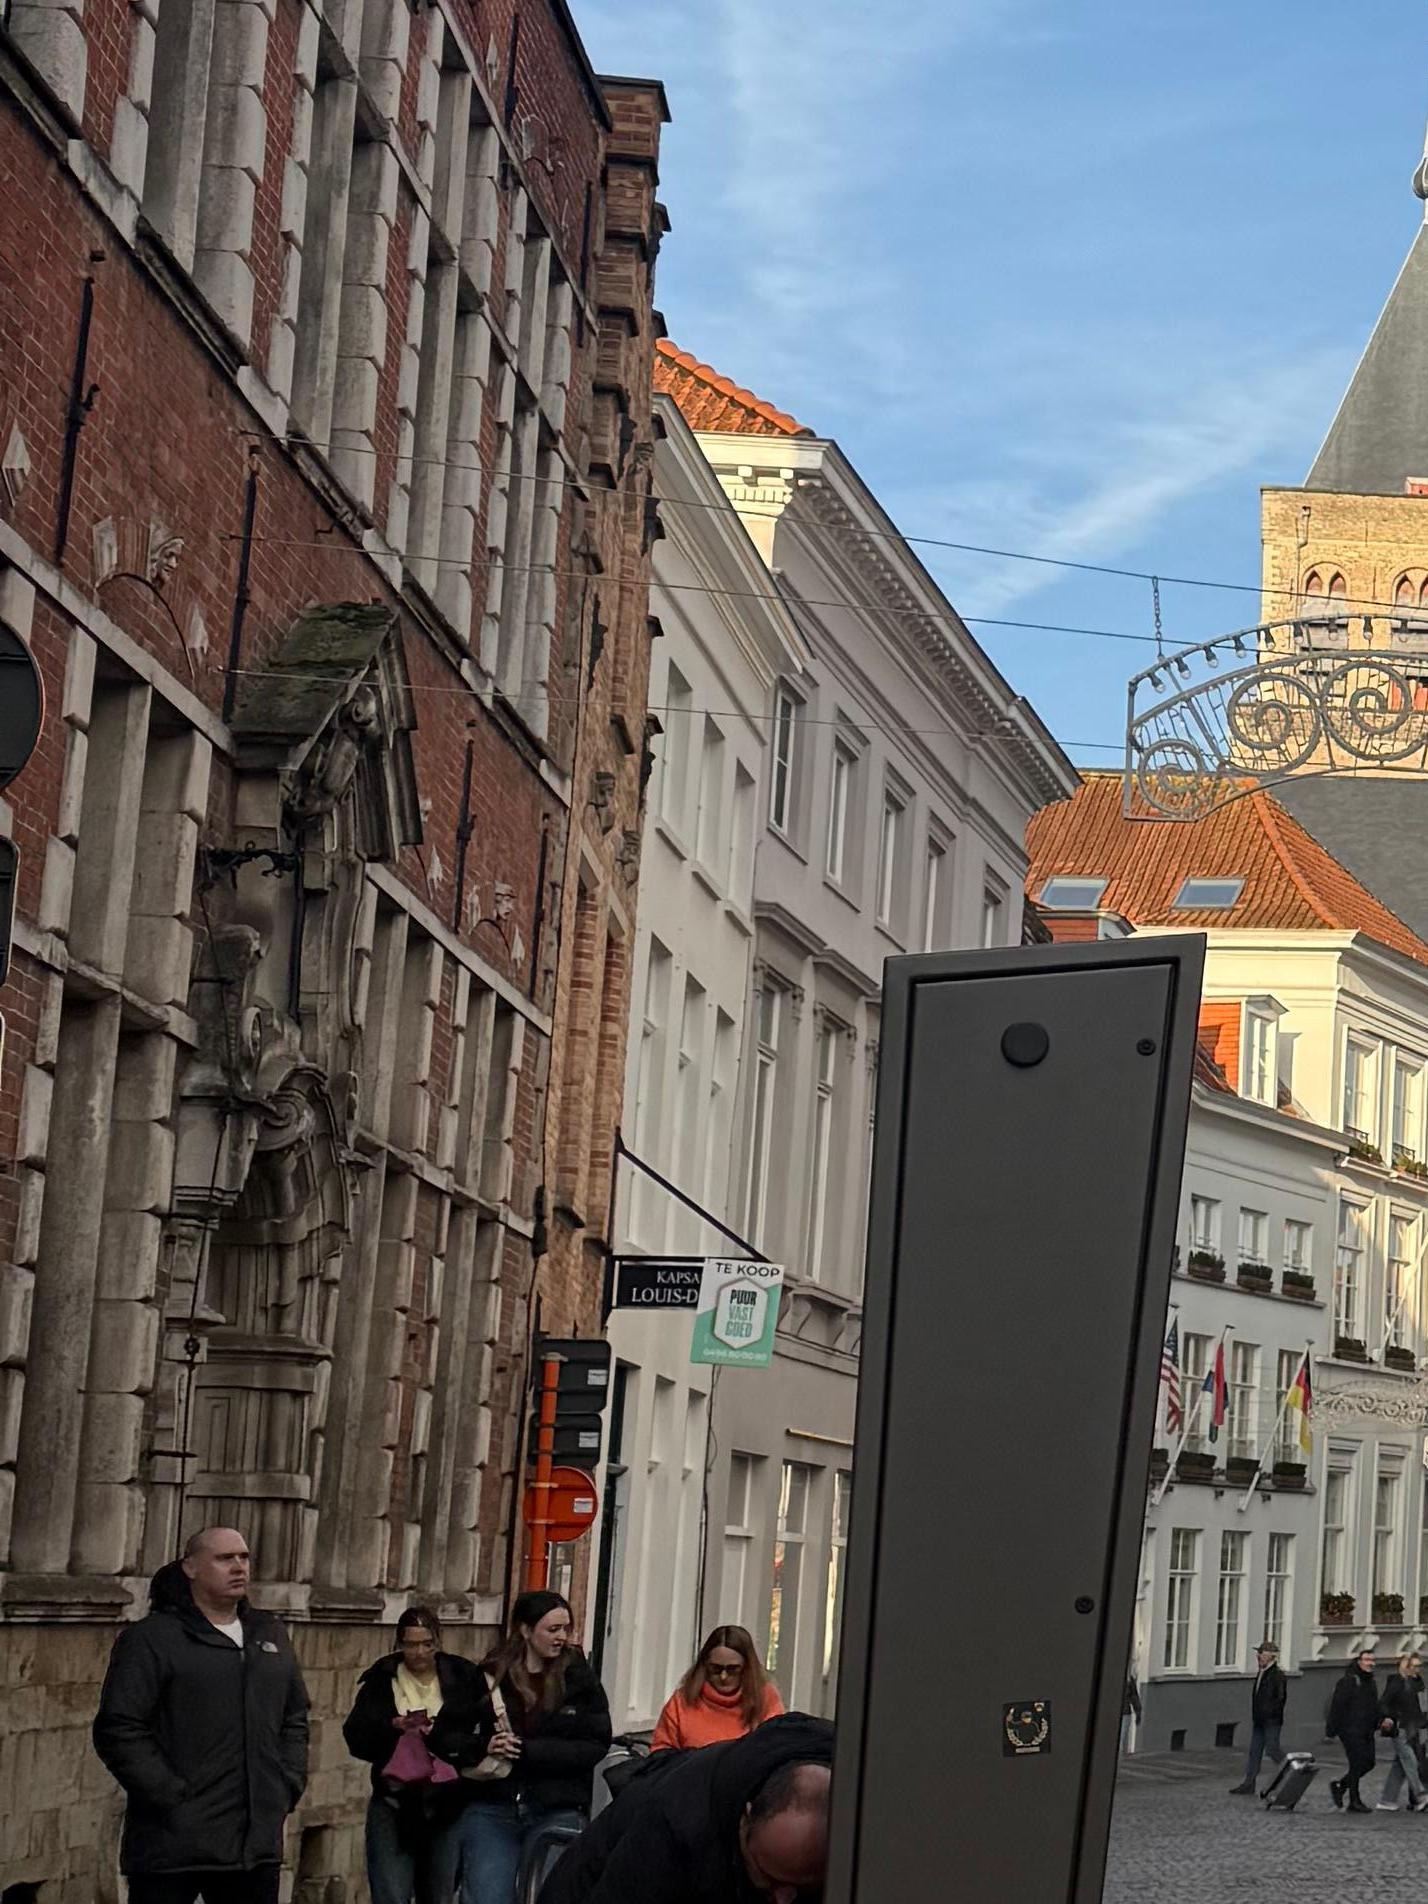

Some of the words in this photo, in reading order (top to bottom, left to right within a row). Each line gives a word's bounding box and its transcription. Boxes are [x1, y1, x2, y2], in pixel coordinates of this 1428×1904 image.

[716, 1262, 732, 1274] TE
[737, 1265, 780, 1278] KOOP
[730, 1289, 757, 1306] PUUR
